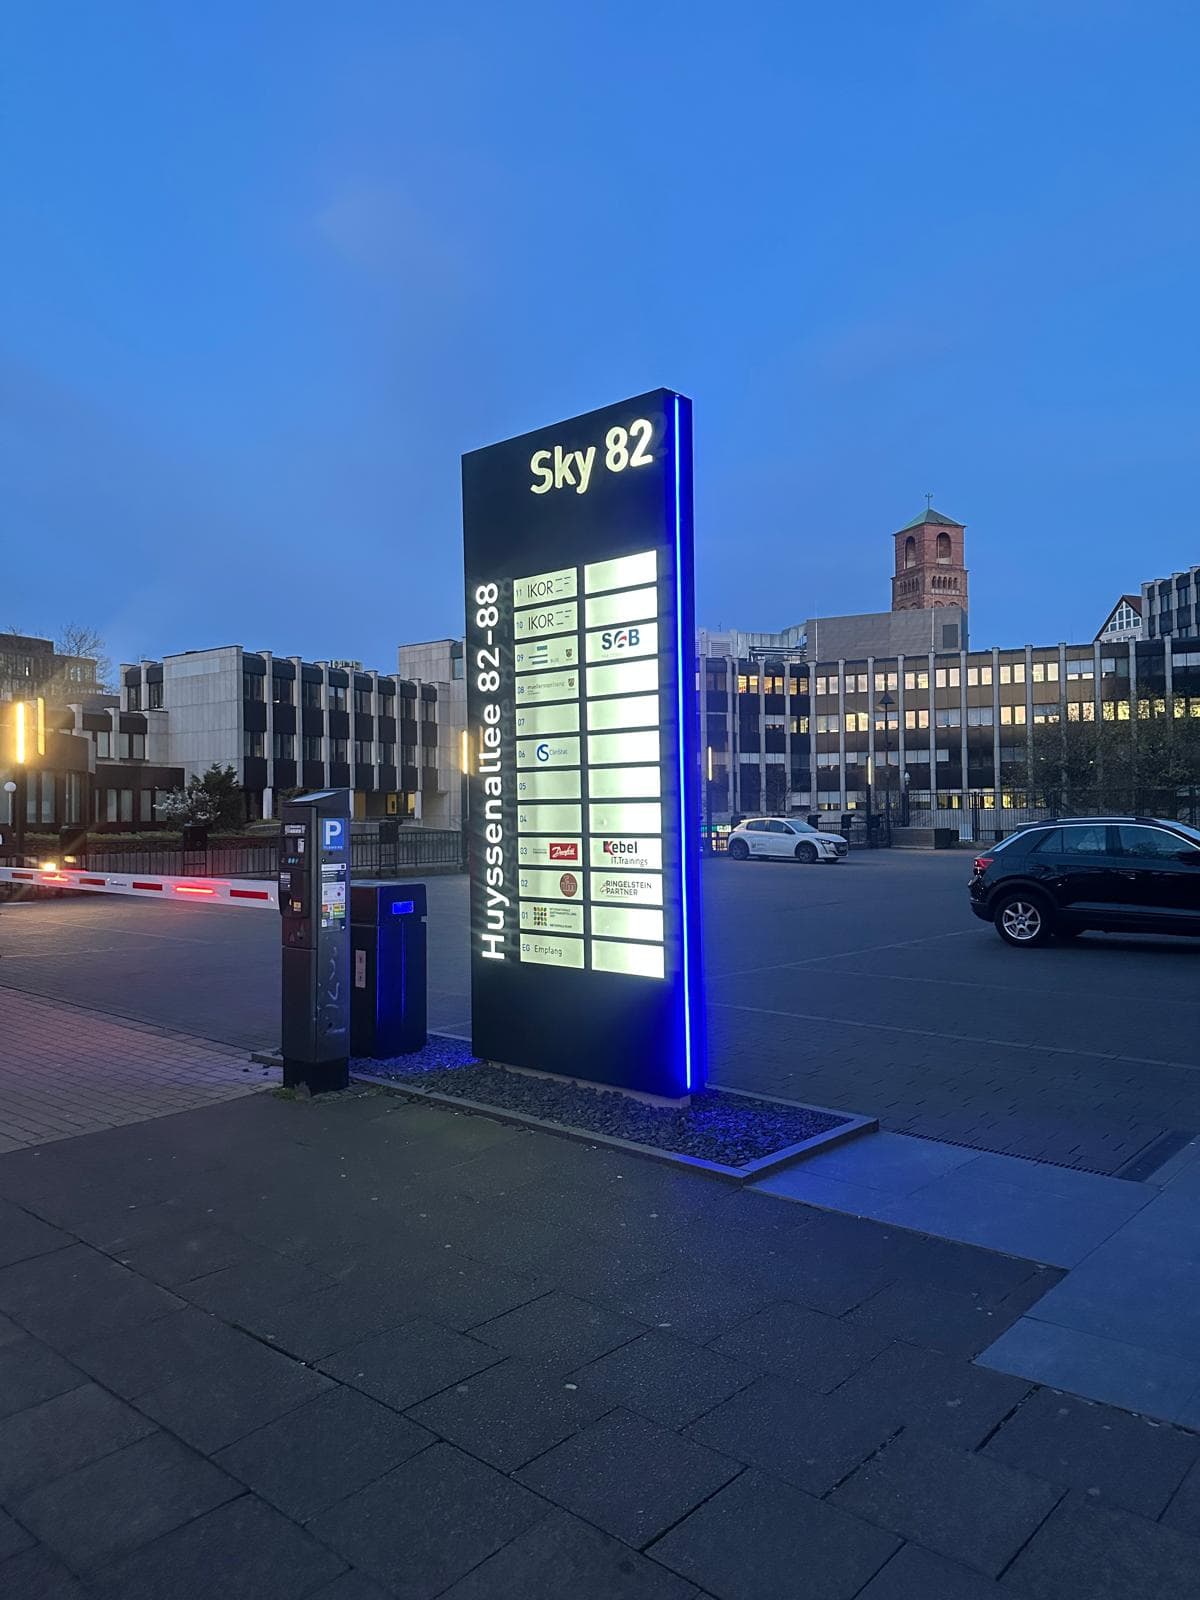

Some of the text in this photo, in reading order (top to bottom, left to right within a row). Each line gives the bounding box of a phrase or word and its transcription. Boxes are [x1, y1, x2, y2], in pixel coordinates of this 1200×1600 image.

[530, 418, 654, 494] Sky 82
[527, 580, 554, 598] IKOR
[517, 613, 554, 631] 10 IKOR
[517, 654, 524, 662] 09
[517, 686, 525, 694] 08
[518, 718, 525, 726] 07
[518, 750, 526, 758] 06
[475, 582, 510, 960] Huyssenallee 82-88
[519, 782, 527, 790] 05
[519, 815, 527, 823] 04
[325, 820, 342, 845] P
[520, 847, 528, 855] 03
[603, 840, 638, 855] Kebel
[520, 879, 528, 888] 02
[606, 880, 652, 889] RINGELSTEIN
[606, 888, 638, 896] PARTNER
[521, 911, 529, 920] 01
[522, 943, 563, 957] EG Empfang
